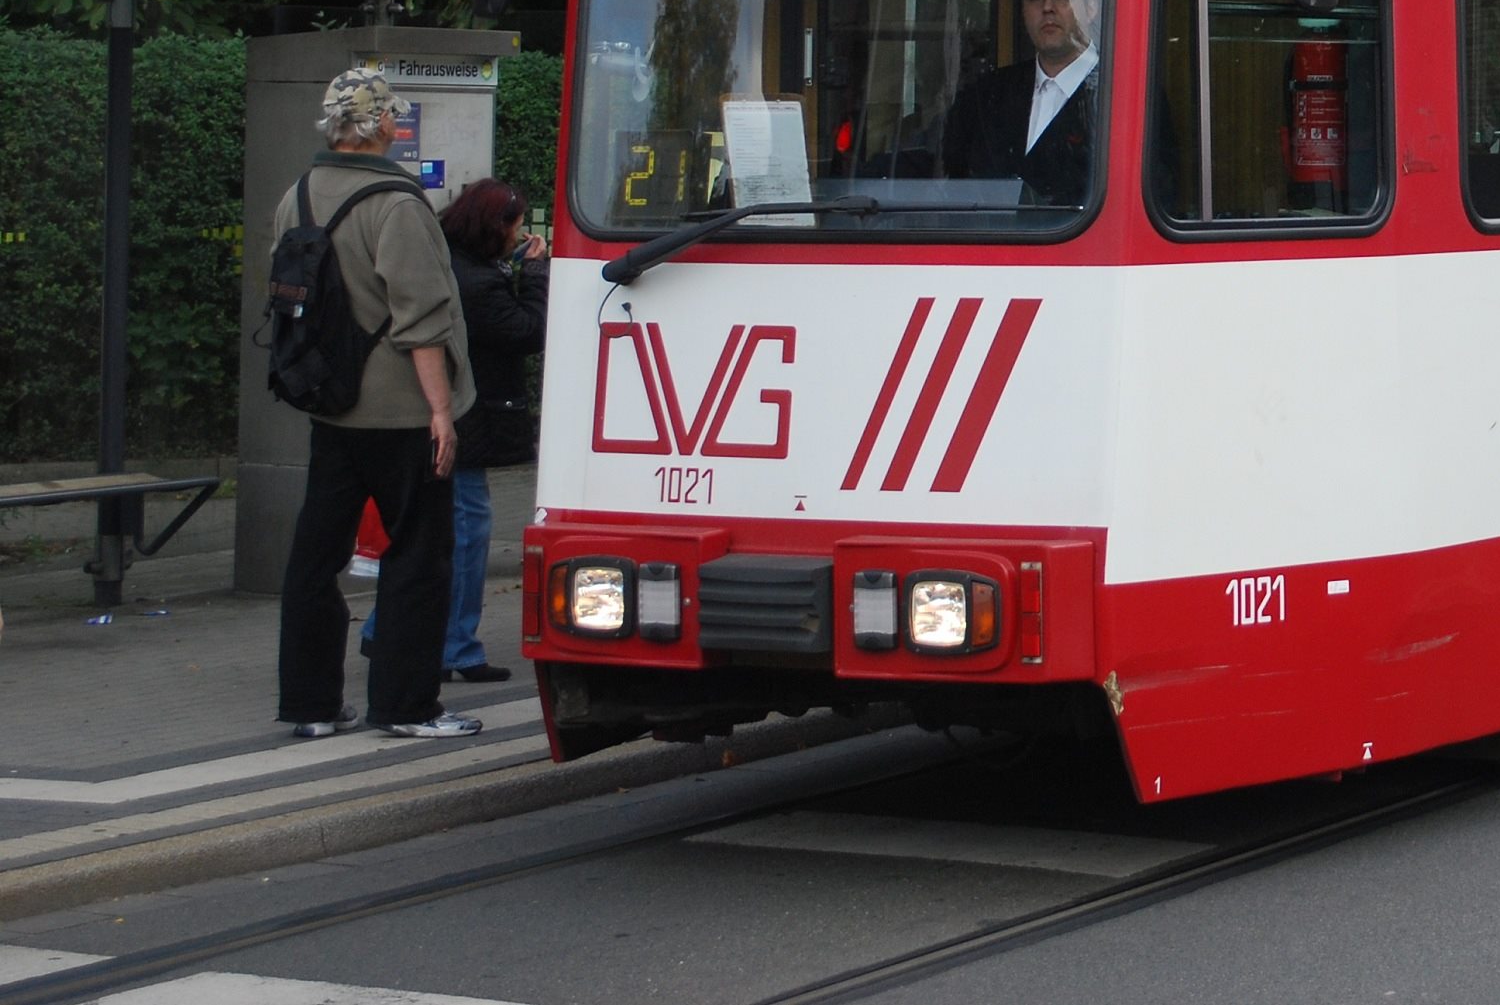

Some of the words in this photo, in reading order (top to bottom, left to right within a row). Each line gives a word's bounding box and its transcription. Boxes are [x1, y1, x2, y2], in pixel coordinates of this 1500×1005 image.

[399, 59, 478, 78] Fahrausweise
[625, 145, 687, 206] 21
[591, 322, 797, 459] DVG
[655, 466, 714, 504] 1021
[1225, 574, 1286, 627] 1021
[1154, 776, 1161, 794] 1
